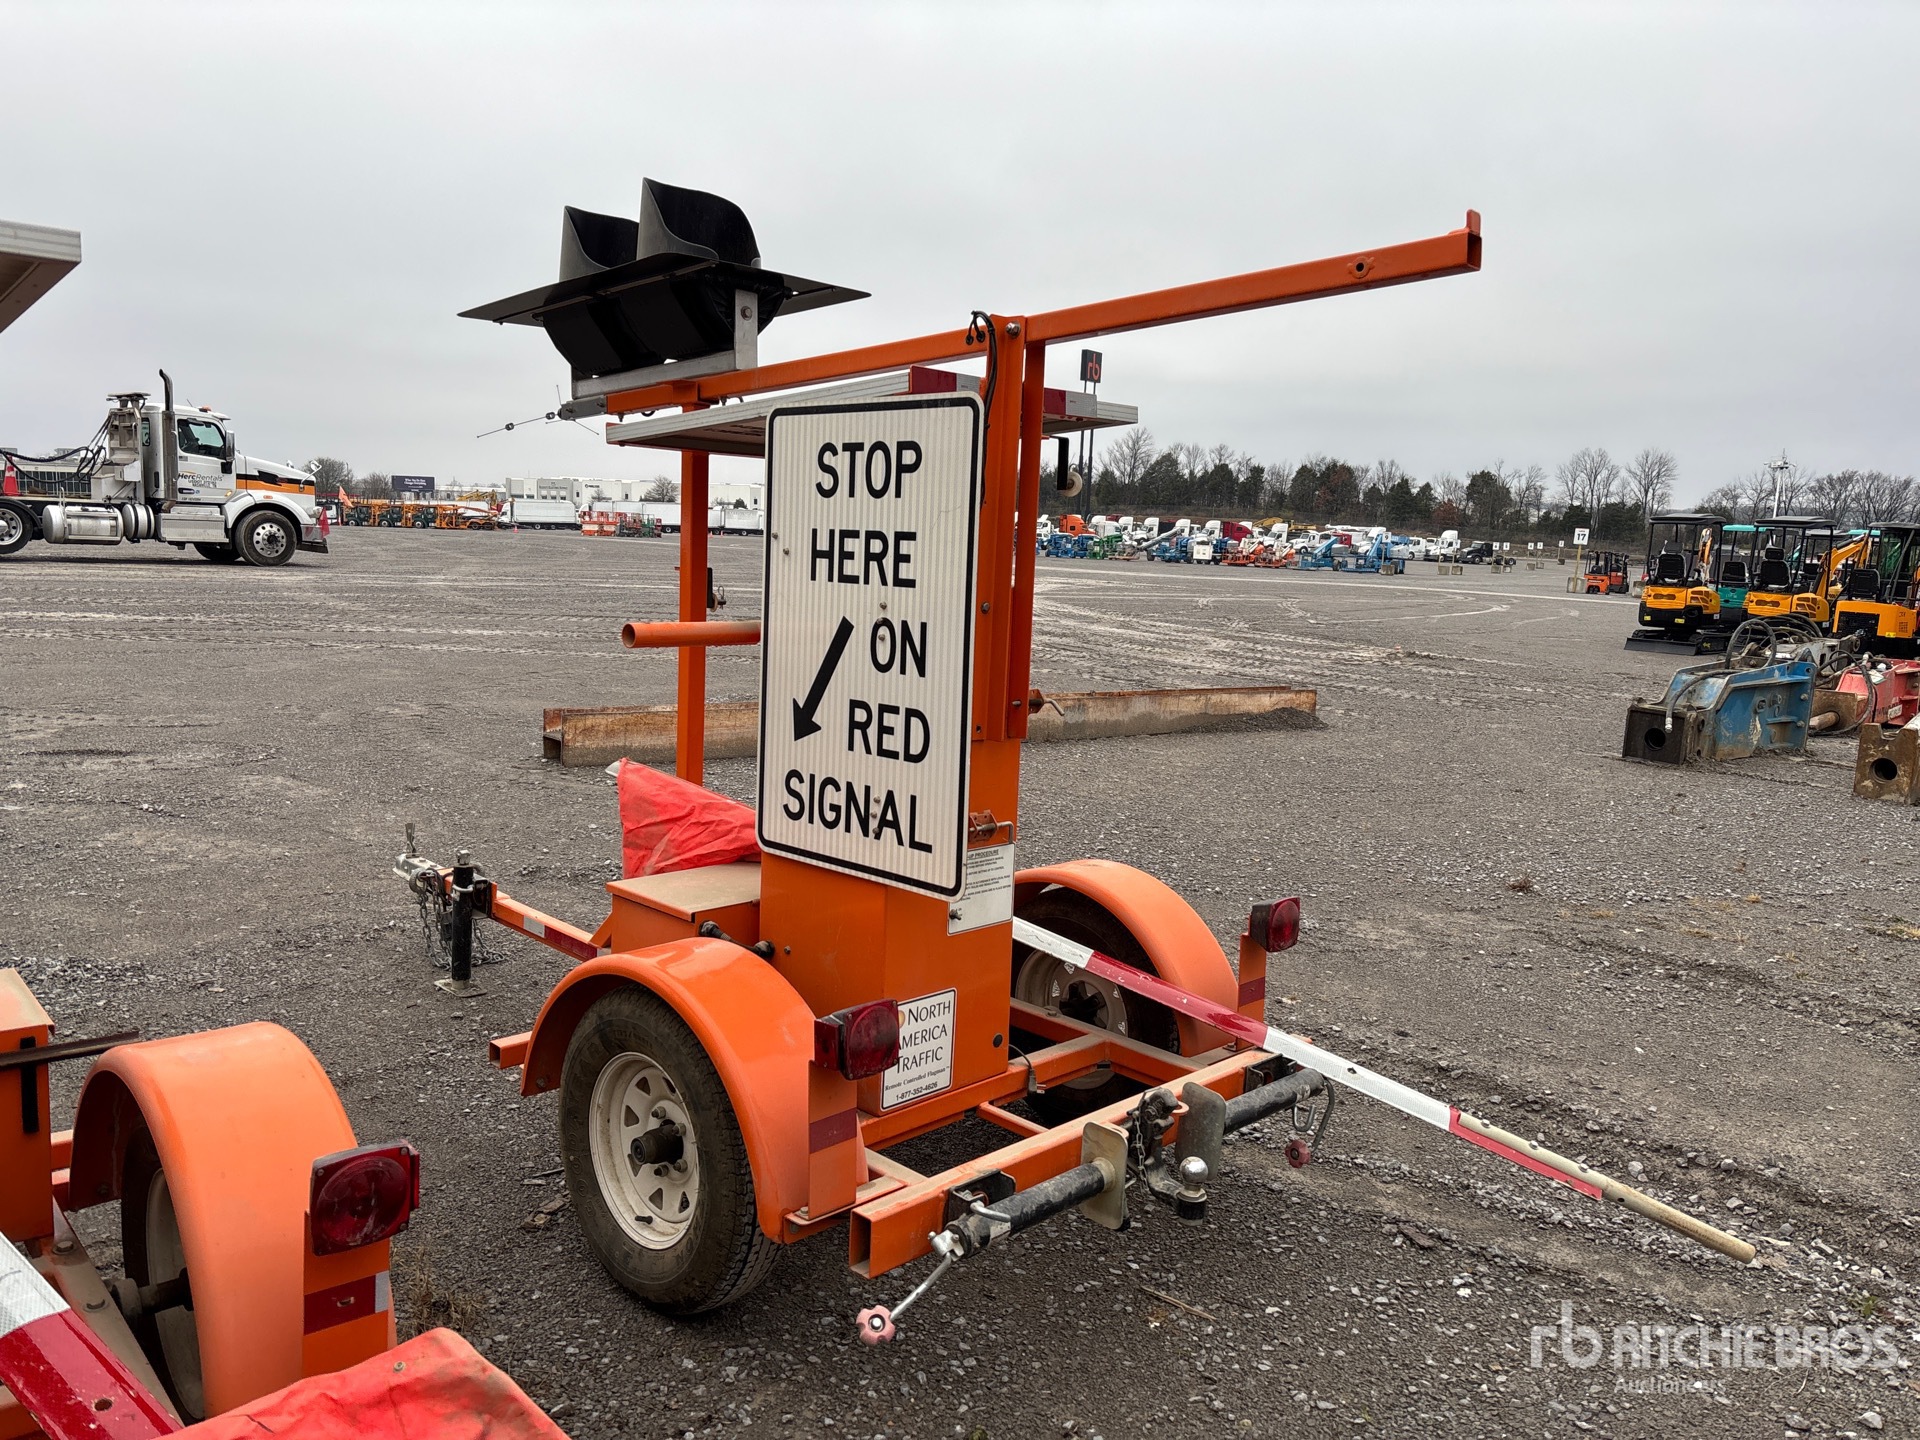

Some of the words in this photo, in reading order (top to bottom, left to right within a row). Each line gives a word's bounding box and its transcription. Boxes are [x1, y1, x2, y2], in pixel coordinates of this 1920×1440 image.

[1087, 353, 1100, 380] rb
[815, 440, 923, 499] STOP
[810, 528, 917, 589] HERE
[1577, 533, 1586, 541] 17
[870, 617, 928, 678] ON
[847, 698, 931, 764] RED
[783, 769, 933, 854] SIGNAL
[908, 1000, 951, 1026] NORTH
[897, 1046, 944, 1074] TRAFFIC
[885, 1082, 902, 1092] Remote
[903, 1073, 926, 1085] Controlled
